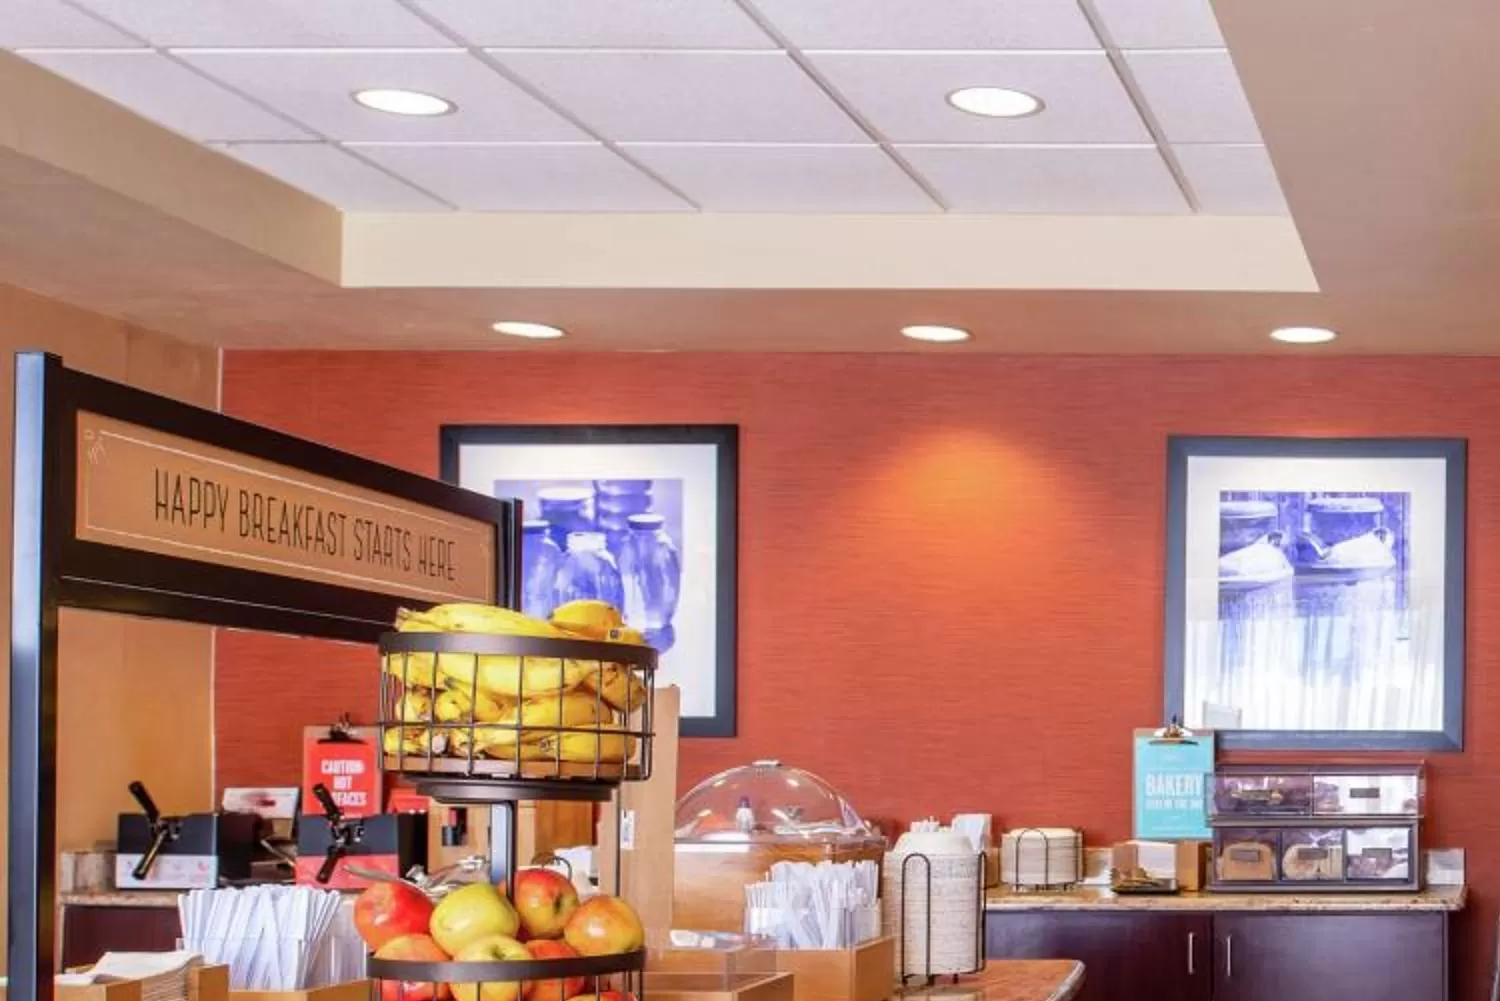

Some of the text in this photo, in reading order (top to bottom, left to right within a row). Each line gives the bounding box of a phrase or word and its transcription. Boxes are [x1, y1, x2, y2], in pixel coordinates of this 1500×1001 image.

[155, 467, 456, 581] HAPPY BREAKFAST STARTS HERE
[1146, 773, 1203, 796] BAKERY
